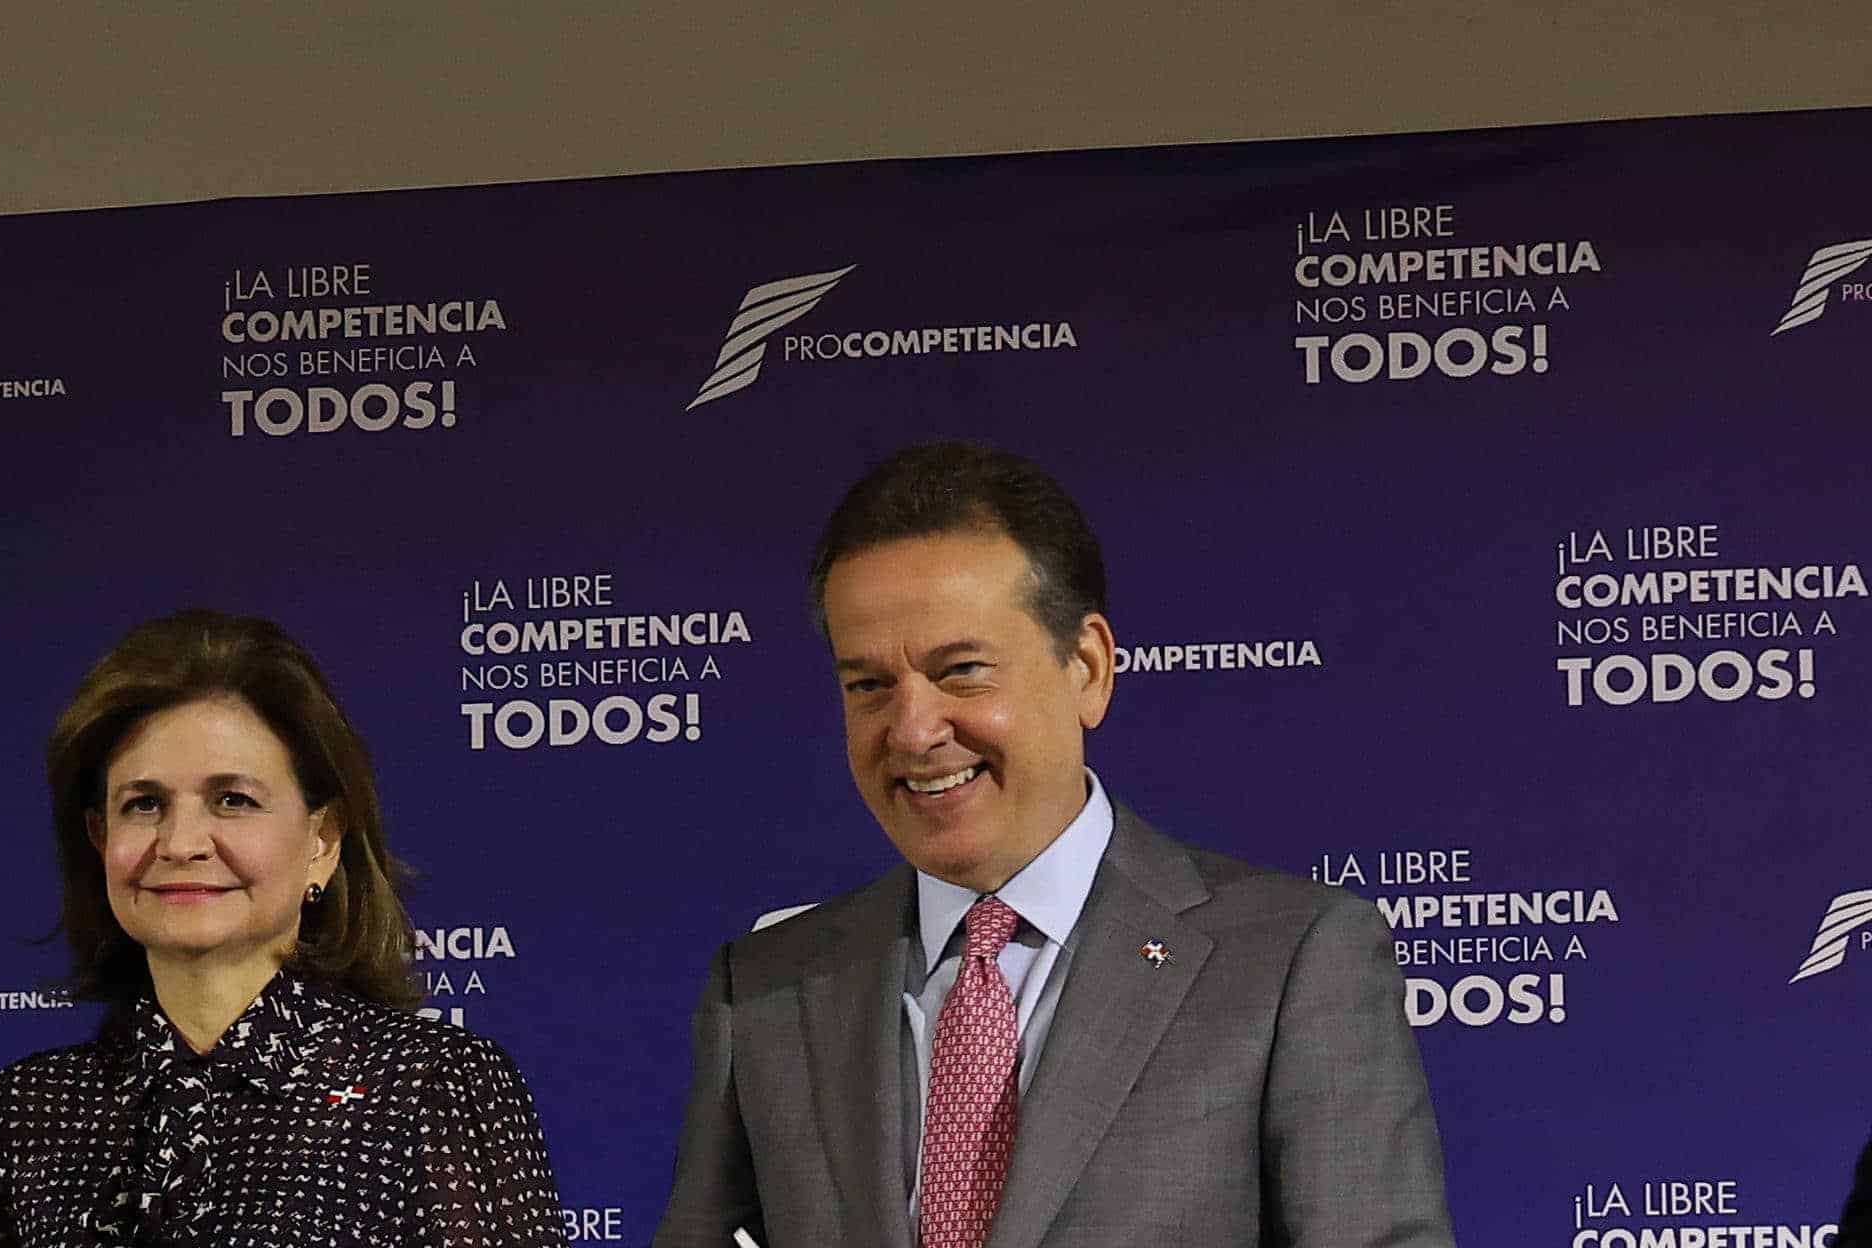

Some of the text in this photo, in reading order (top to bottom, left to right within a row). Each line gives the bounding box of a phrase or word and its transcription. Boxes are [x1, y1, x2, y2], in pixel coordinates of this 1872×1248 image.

[1298, 206, 1453, 254] ¡LA LIBRE
[1294, 240, 1602, 288] COMPETENCIA
[226, 265, 370, 310] ¡LA LIBRE
[1297, 286, 1569, 323] NOS BENEFICIA A
[220, 299, 507, 344] COMPETENCIA
[786, 323, 1077, 360] PROCOMPETENCIA
[224, 345, 476, 378] NOS BENEFICIA A
[1296, 325, 1548, 383] TODOS!
[222, 381, 455, 436] TODOS!
[1559, 526, 1718, 574] ¡LA LIBRE
[464, 575, 611, 622] ¡LA LIBRE
[1555, 564, 1868, 609] COMPETENCIA
[459, 610, 752, 656] COMPETENCIA
[1559, 611, 1835, 645] NOS BENEFICIA A
[463, 655, 721, 690] NOS BENEFICIA A
[1114, 640, 1323, 675] OMPETENCIA
[1558, 650, 1815, 705] TODOS!
[462, 694, 700, 748] TODOS!
[1381, 851, 1470, 883] LIBRE
[1376, 890, 1619, 929] MPETENCIA
[1395, 935, 1586, 965] BENEFICIA A
[464, 969, 486, 995] A
[1404, 974, 1566, 1027] DOS!
[562, 1208, 623, 1241] BRE
[1576, 1182, 1736, 1228] ¡LA LIBRE
